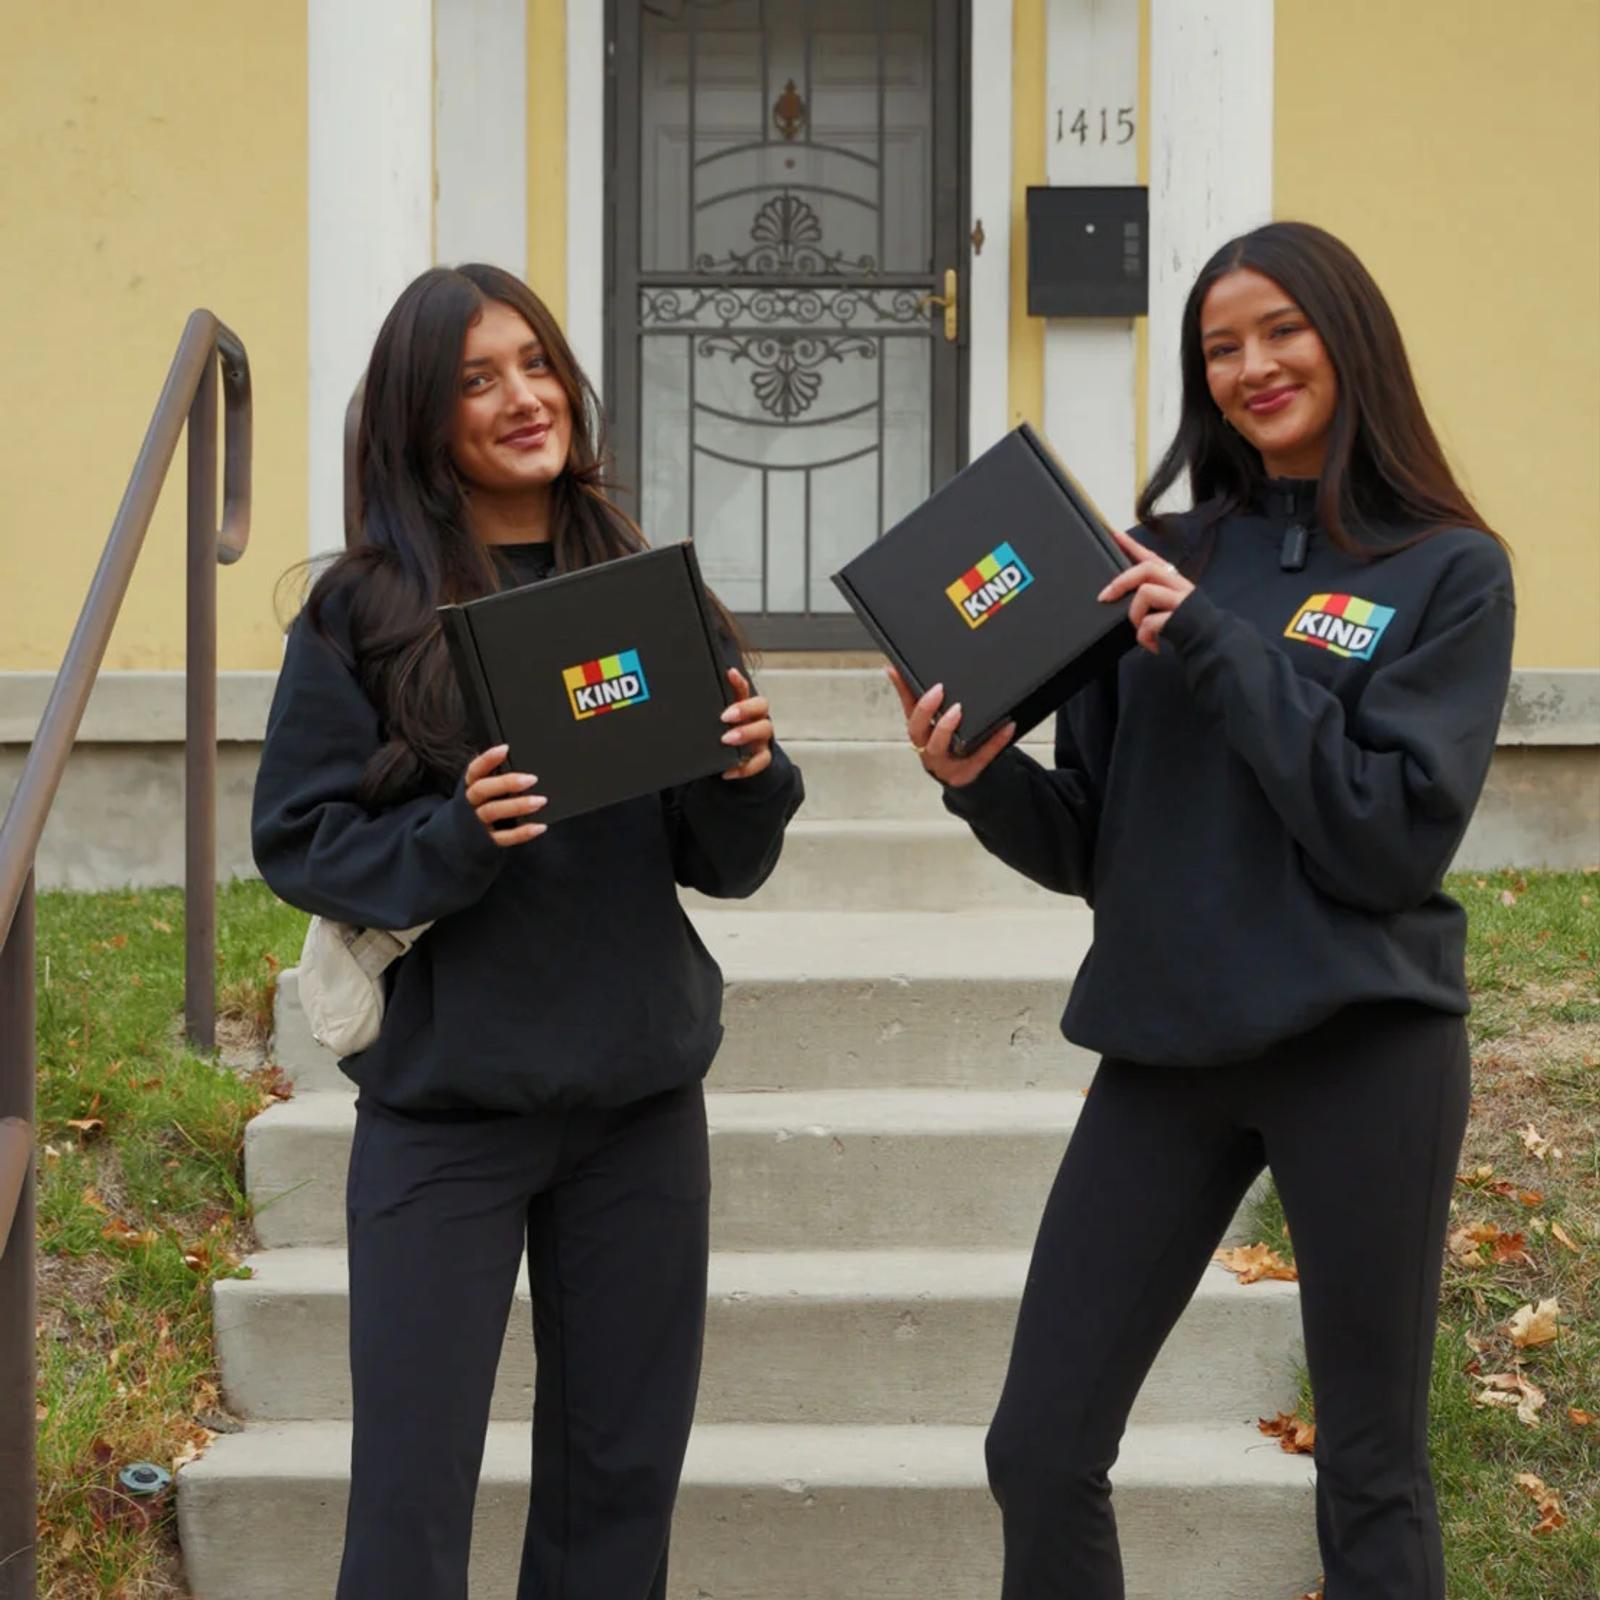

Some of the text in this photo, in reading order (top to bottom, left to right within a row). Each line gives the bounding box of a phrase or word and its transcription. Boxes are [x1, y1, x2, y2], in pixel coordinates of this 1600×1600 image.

[1056, 107, 1135, 145] 1415
[963, 565, 1021, 618] KIND
[1295, 612, 1375, 650] KIND
[575, 675, 639, 711] KIND
